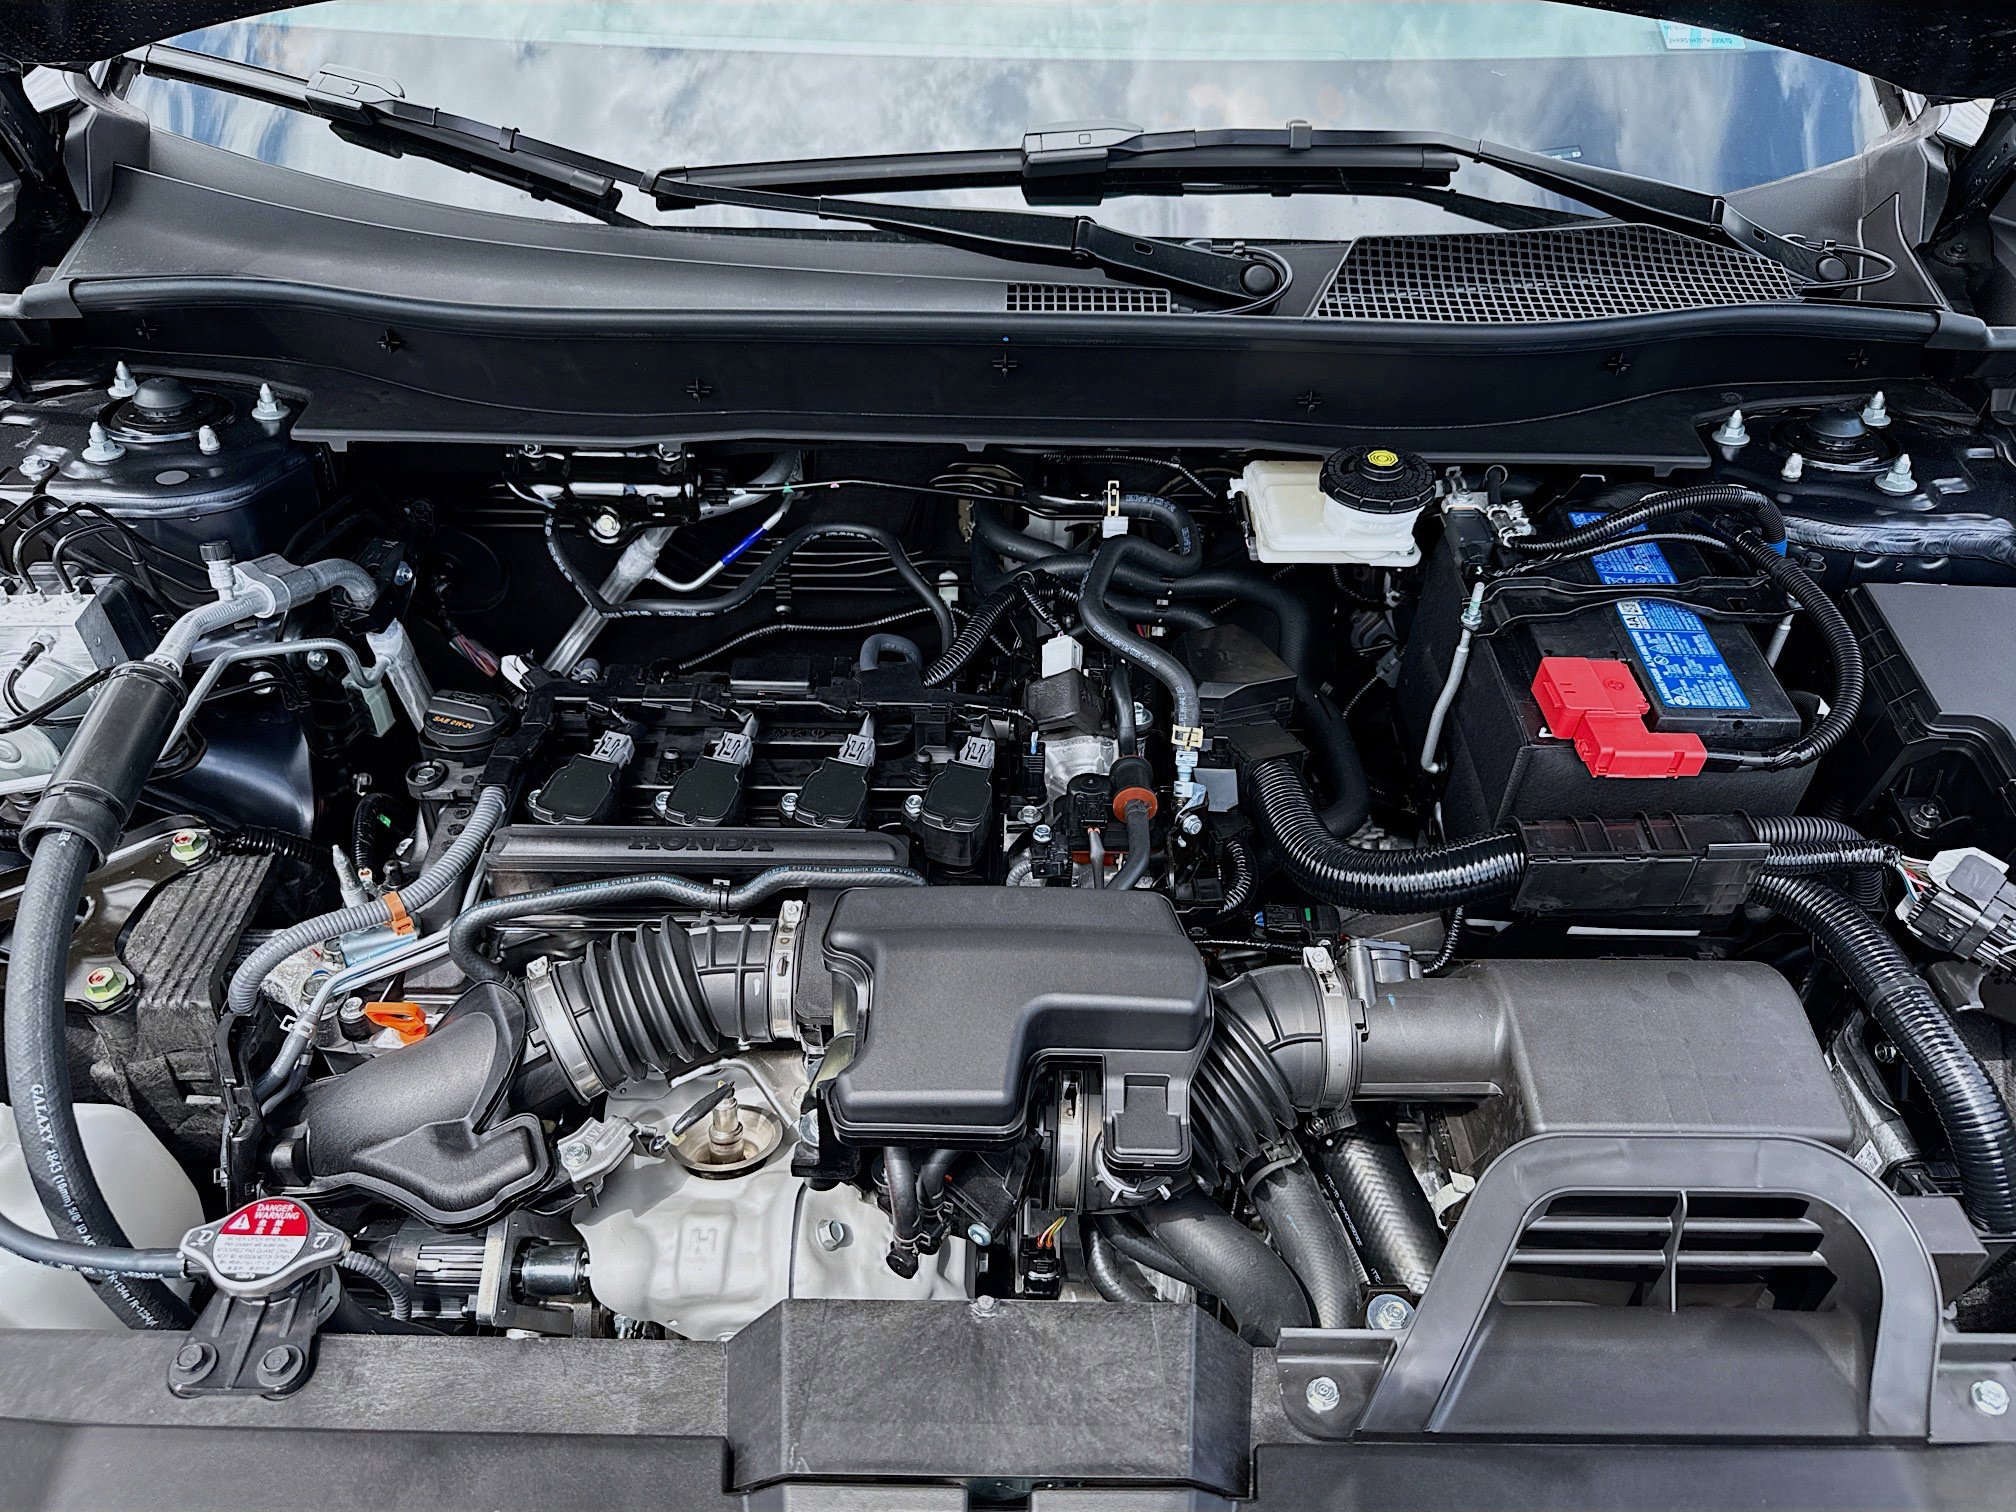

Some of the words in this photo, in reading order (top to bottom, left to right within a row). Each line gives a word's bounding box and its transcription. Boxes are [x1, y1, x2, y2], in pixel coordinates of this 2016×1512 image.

[628, 836, 774, 852] HONDA
[31, 1083, 55, 1144] GALAXY
[257, 1203, 295, 1211] DANGER
[254, 1211, 300, 1220] WARNUNG
